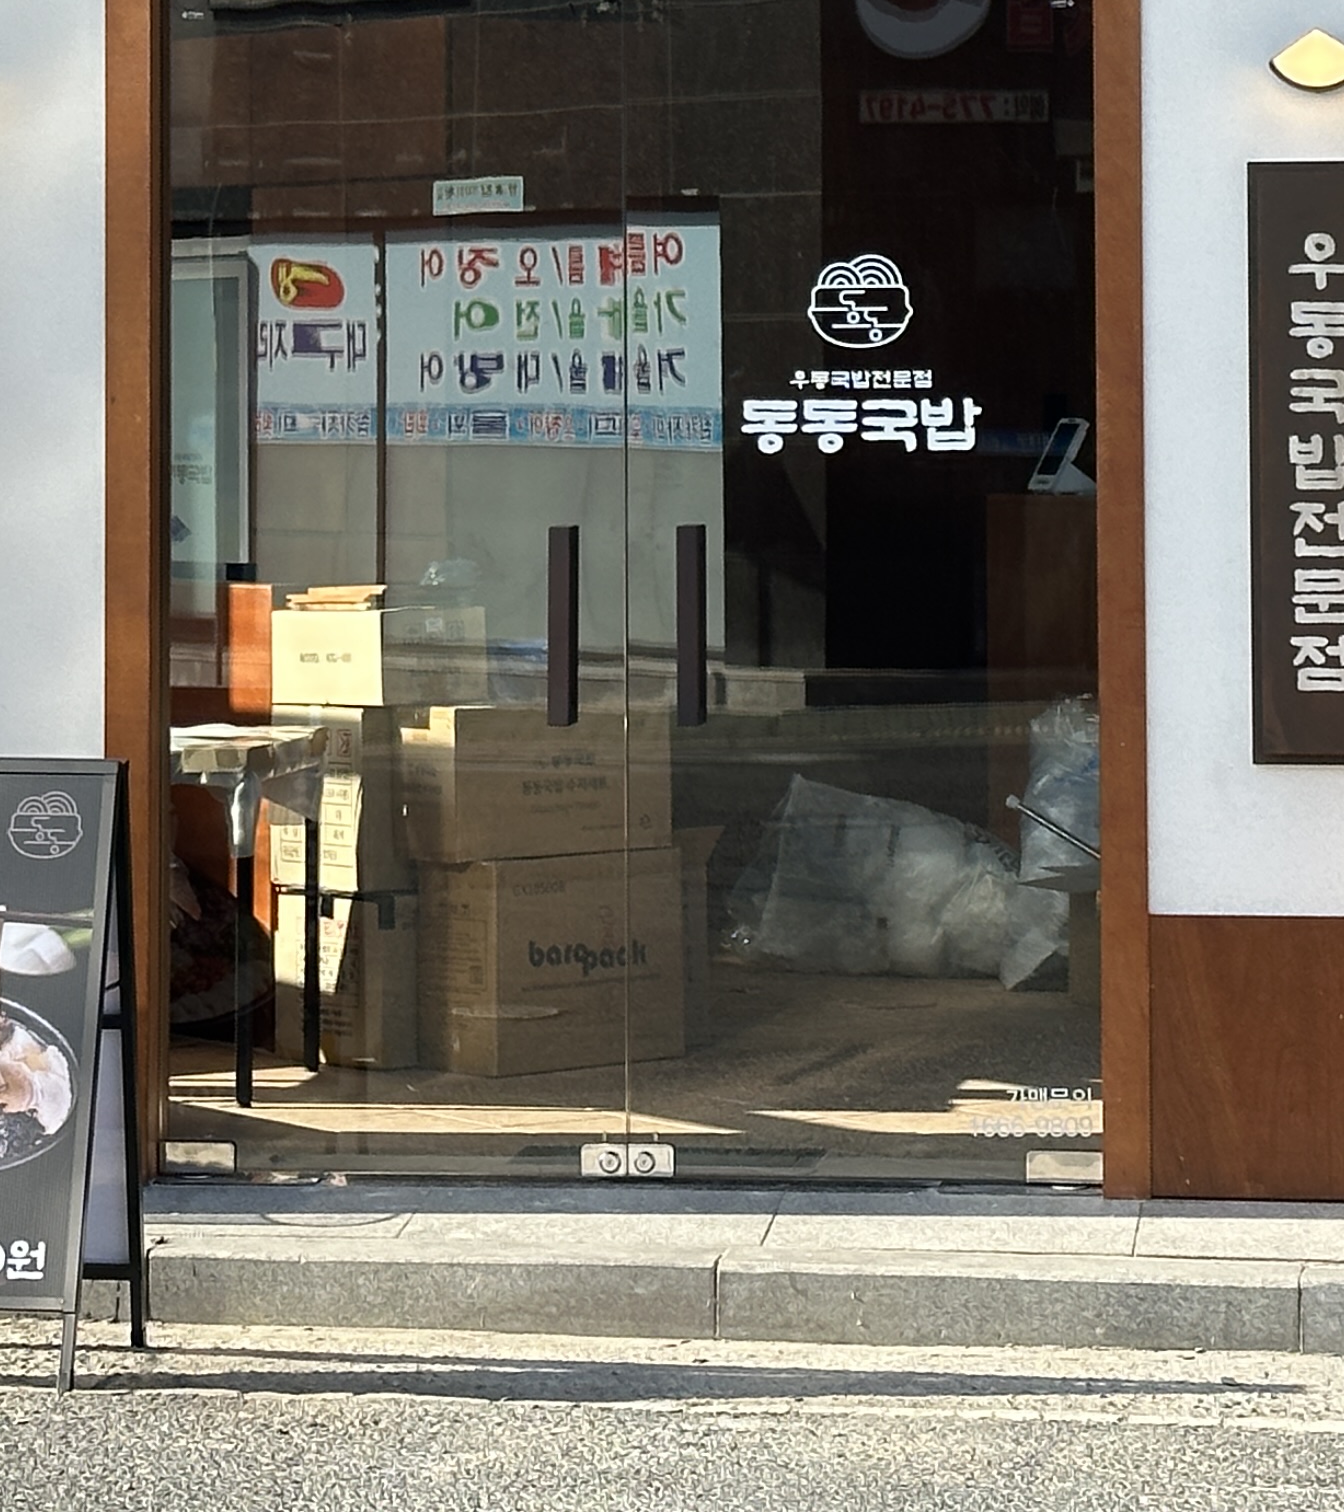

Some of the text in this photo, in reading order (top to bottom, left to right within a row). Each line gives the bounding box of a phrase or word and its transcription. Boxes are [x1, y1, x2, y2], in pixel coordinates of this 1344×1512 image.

[789, 369, 934, 391] 우동국밥전문점
[741, 396, 984, 455] 동동국밥
[1006, 1087, 1093, 1110] 가맹문의
